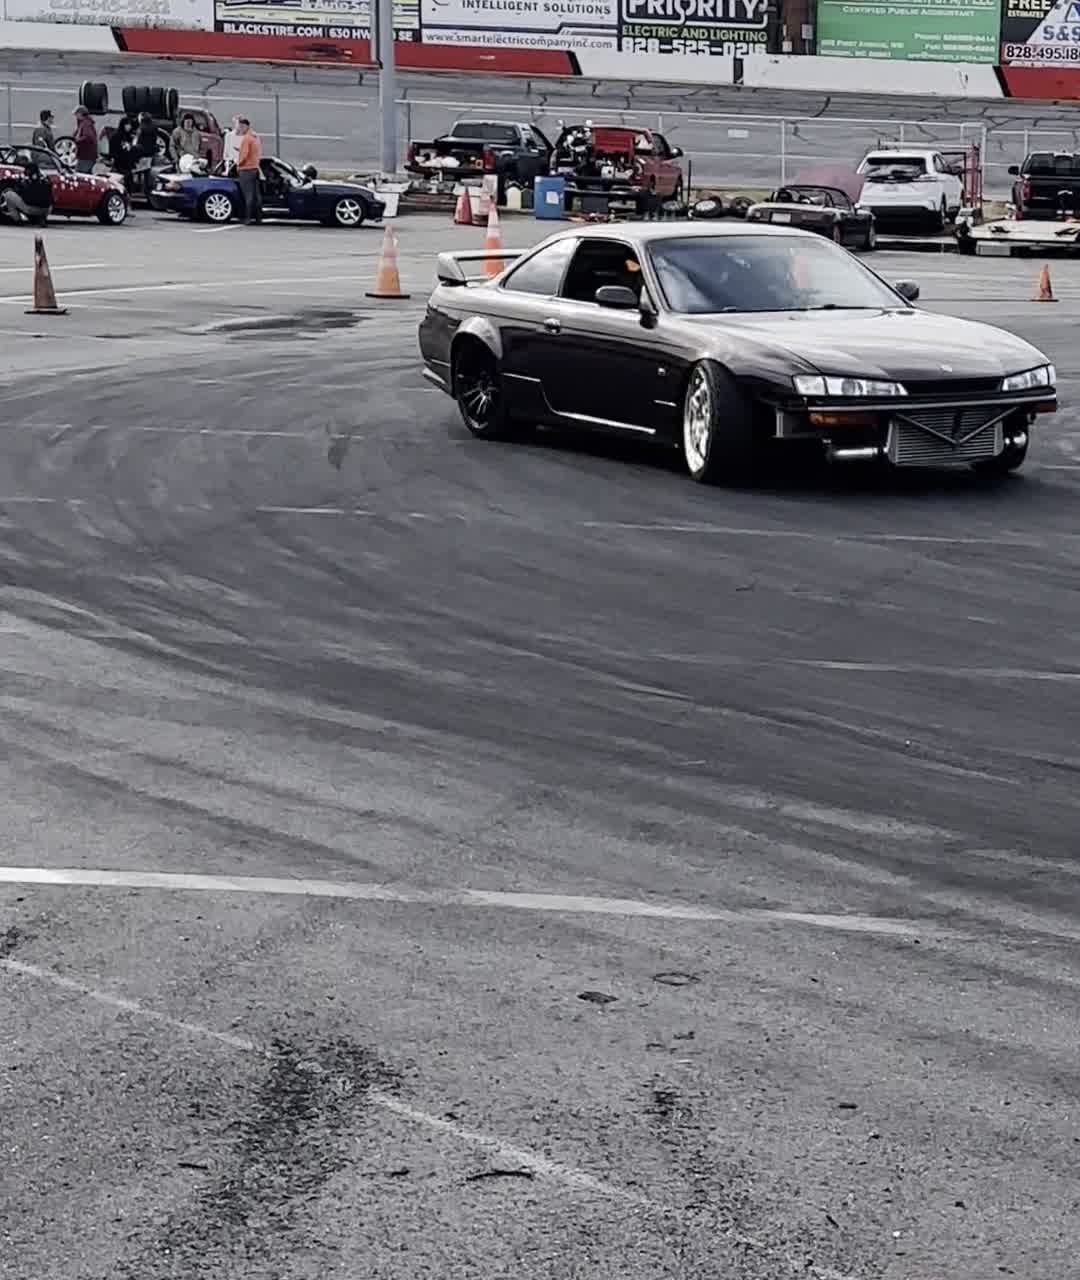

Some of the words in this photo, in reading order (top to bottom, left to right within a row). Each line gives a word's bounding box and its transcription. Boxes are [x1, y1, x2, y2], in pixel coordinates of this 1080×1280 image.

[462, 0, 538, 12] INTELLIGENT
[543, 4, 611, 15] SOLUTIONS
[223, 23, 323, 38] BLACKSTIRE.COM
[328, 27, 350, 38] 630
[623, 25, 678, 38] ELECTRIC
[681, 29, 708, 40] AND
[710, 31, 768, 42] LIGHTING
[426, 33, 613, 49] www.smartelectriccompanyinc.com
